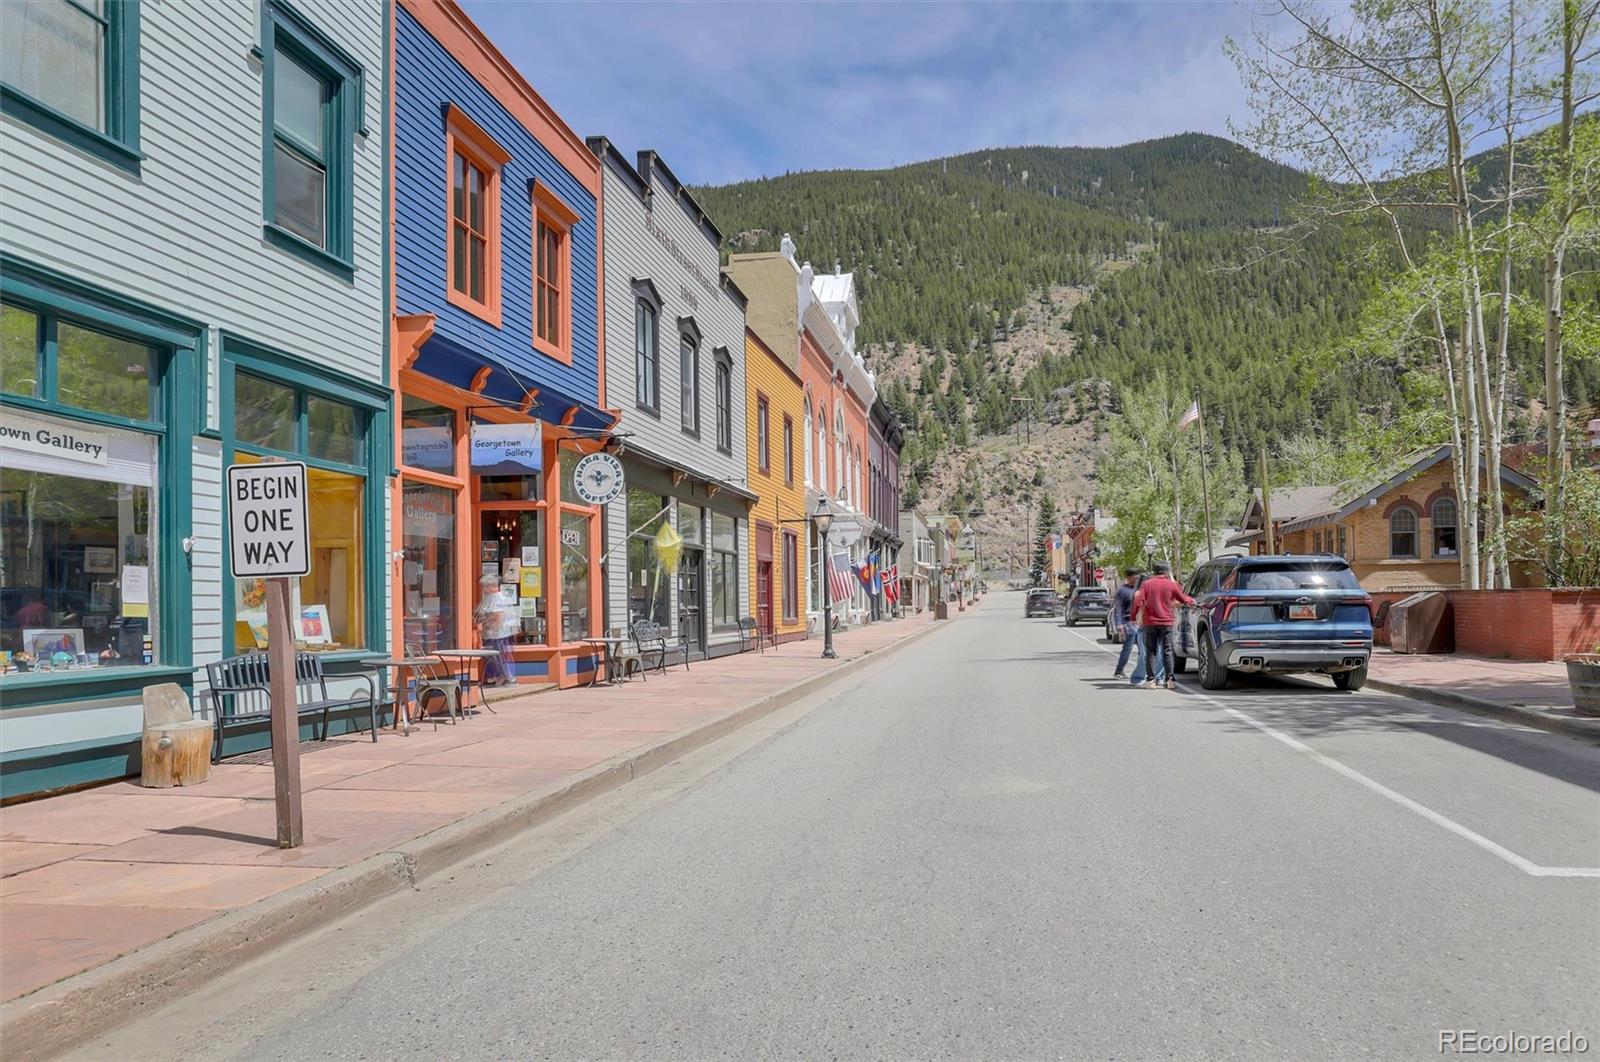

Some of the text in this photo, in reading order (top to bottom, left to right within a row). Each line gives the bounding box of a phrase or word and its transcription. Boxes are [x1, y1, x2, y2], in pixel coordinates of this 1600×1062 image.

[36, 430, 102, 458] Gallery
[474, 440, 521, 449] Georgetown
[505, 449, 533, 457] Gallery
[236, 476, 297, 500] BEGIN
[579, 488, 618, 502] COFFEE
[244, 509, 294, 533] ONE
[406, 505, 437, 523] Gallery
[243, 541, 294, 565] WAY
